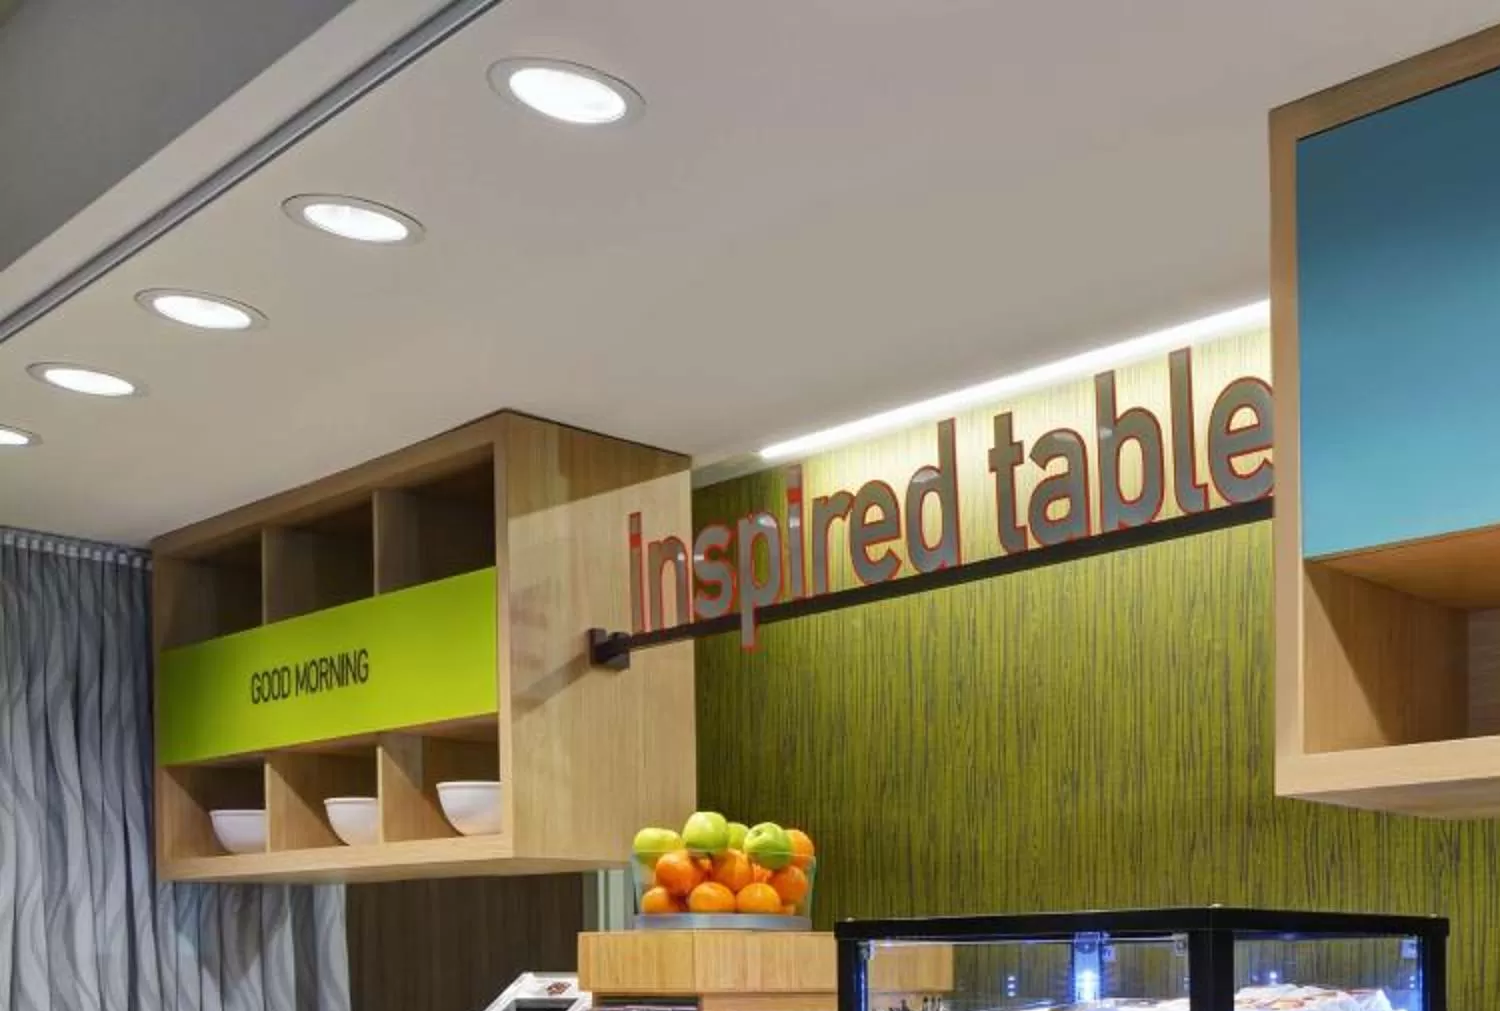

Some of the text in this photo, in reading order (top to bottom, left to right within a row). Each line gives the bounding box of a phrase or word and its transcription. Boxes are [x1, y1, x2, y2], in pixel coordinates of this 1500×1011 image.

[628, 348, 1273, 651] inspired table
[251, 648, 369, 705] GOOD MORNING
